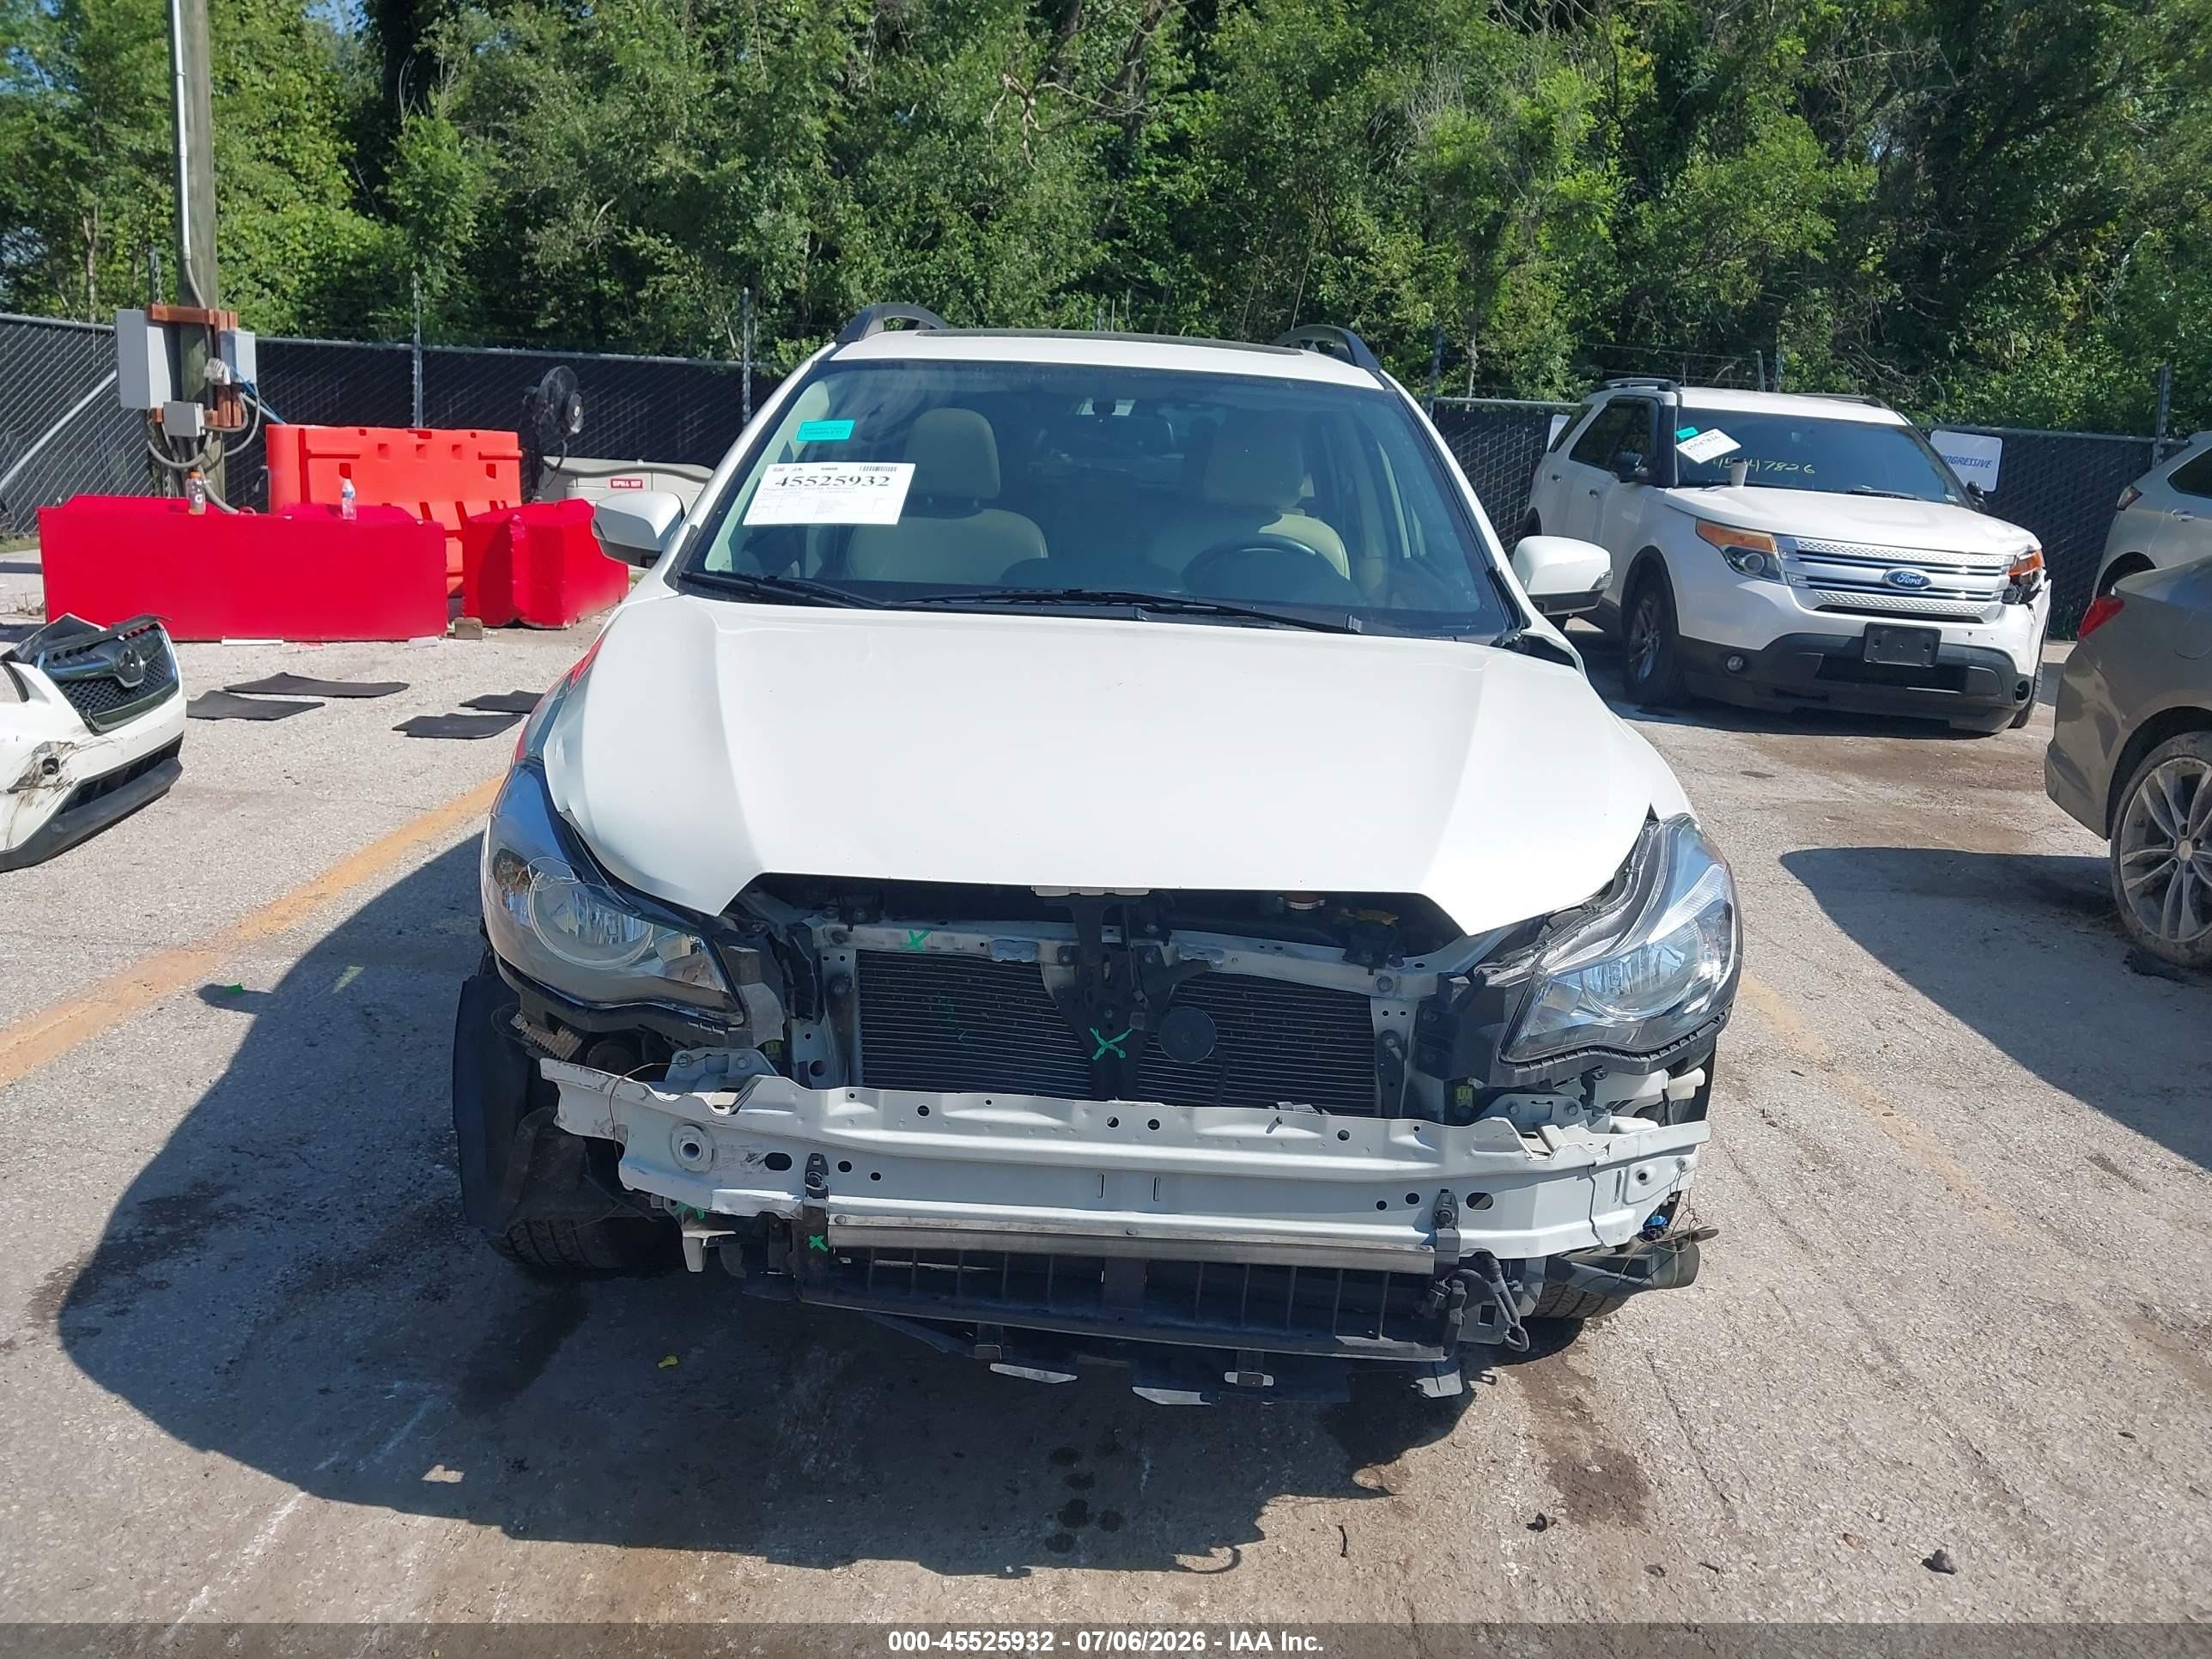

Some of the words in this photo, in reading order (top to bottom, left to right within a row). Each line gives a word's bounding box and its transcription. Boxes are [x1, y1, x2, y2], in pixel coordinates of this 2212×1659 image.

[1713, 457, 1815, 474] 4547826
[1943, 454, 1992, 468] OGRESSIVE
[775, 476, 891, 487] 45525932
[1897, 572, 1923, 585] Ford
